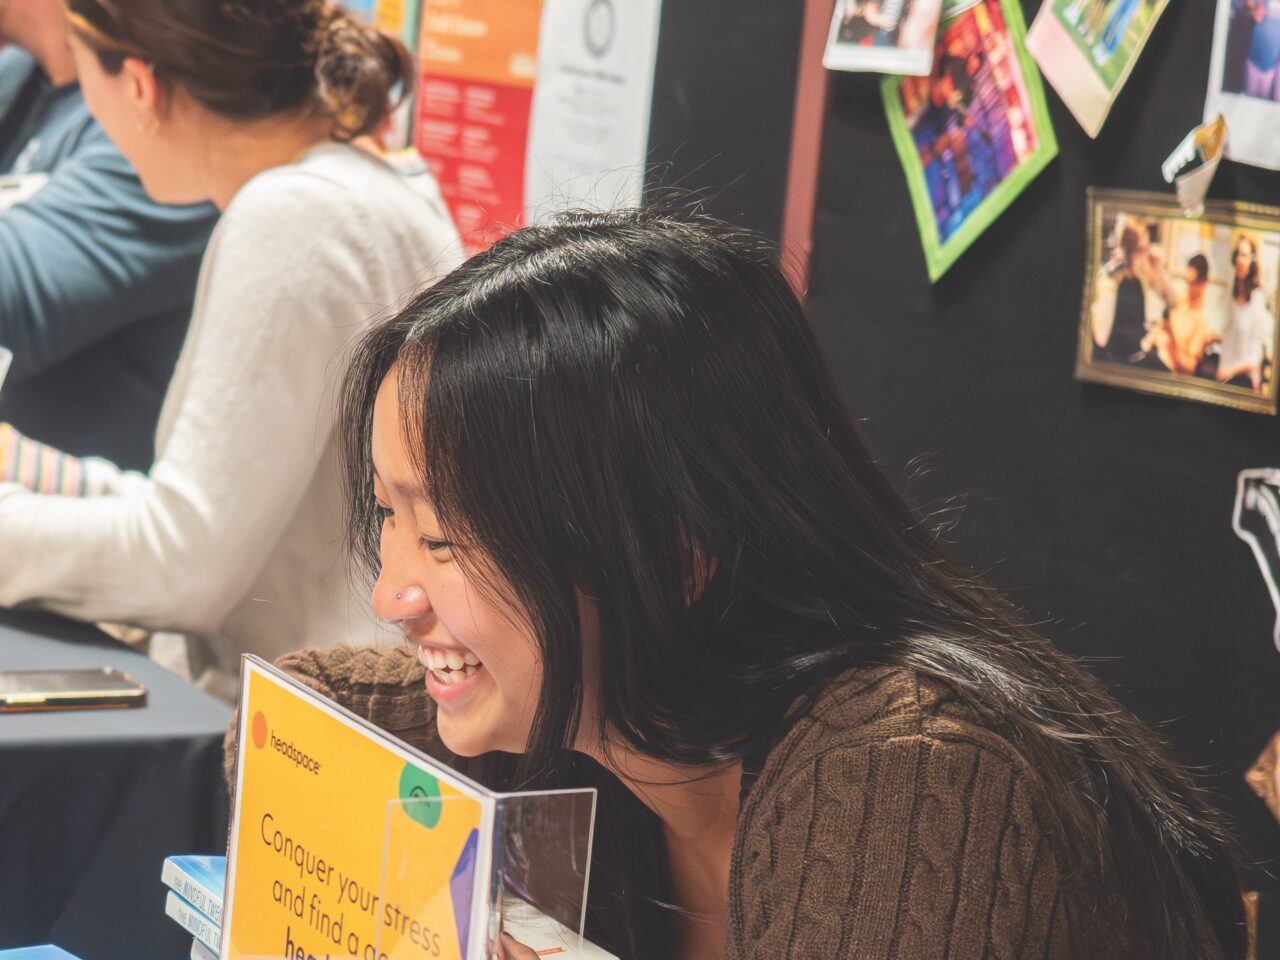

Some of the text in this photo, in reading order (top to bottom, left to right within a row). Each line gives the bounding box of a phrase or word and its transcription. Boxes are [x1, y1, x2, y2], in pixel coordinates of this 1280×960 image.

[270, 729, 321, 776] headspace
[261, 813, 443, 958] Conquer your stress
[272, 878, 305, 919] and
[309, 892, 343, 946] find
[347, 932, 359, 956] a
